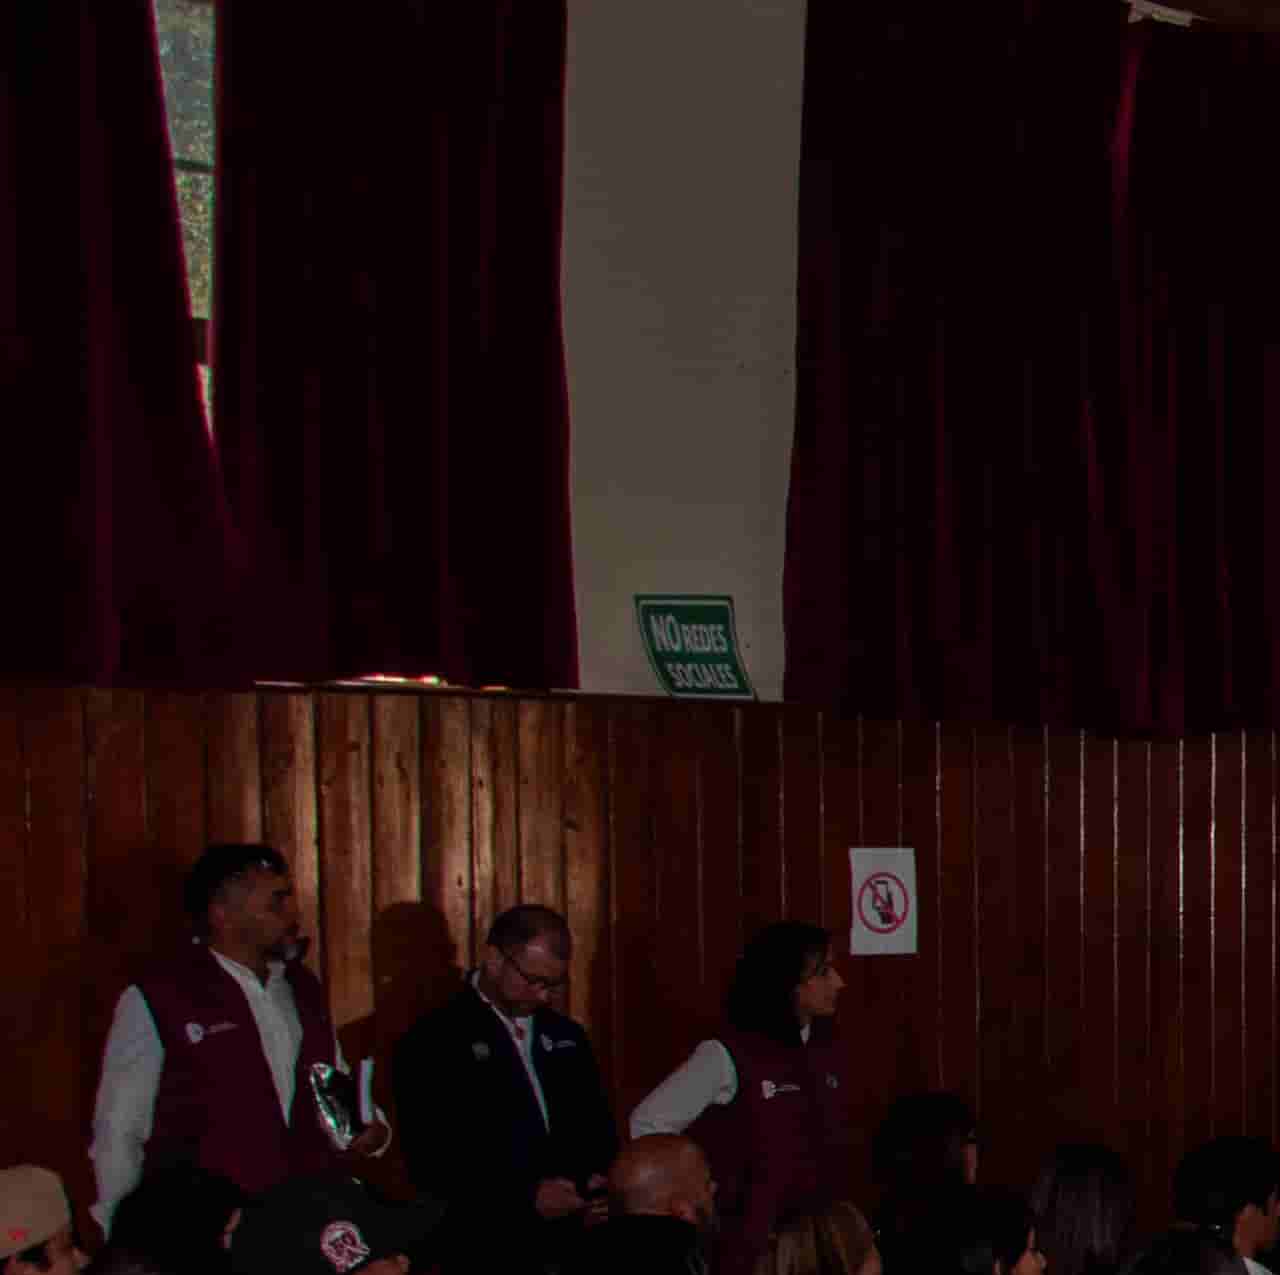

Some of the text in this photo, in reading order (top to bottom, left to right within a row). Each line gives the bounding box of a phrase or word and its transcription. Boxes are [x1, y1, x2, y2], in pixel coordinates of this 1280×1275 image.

[649, 613, 729, 655] NO REDES
[666, 662, 739, 689] SOCIALES
